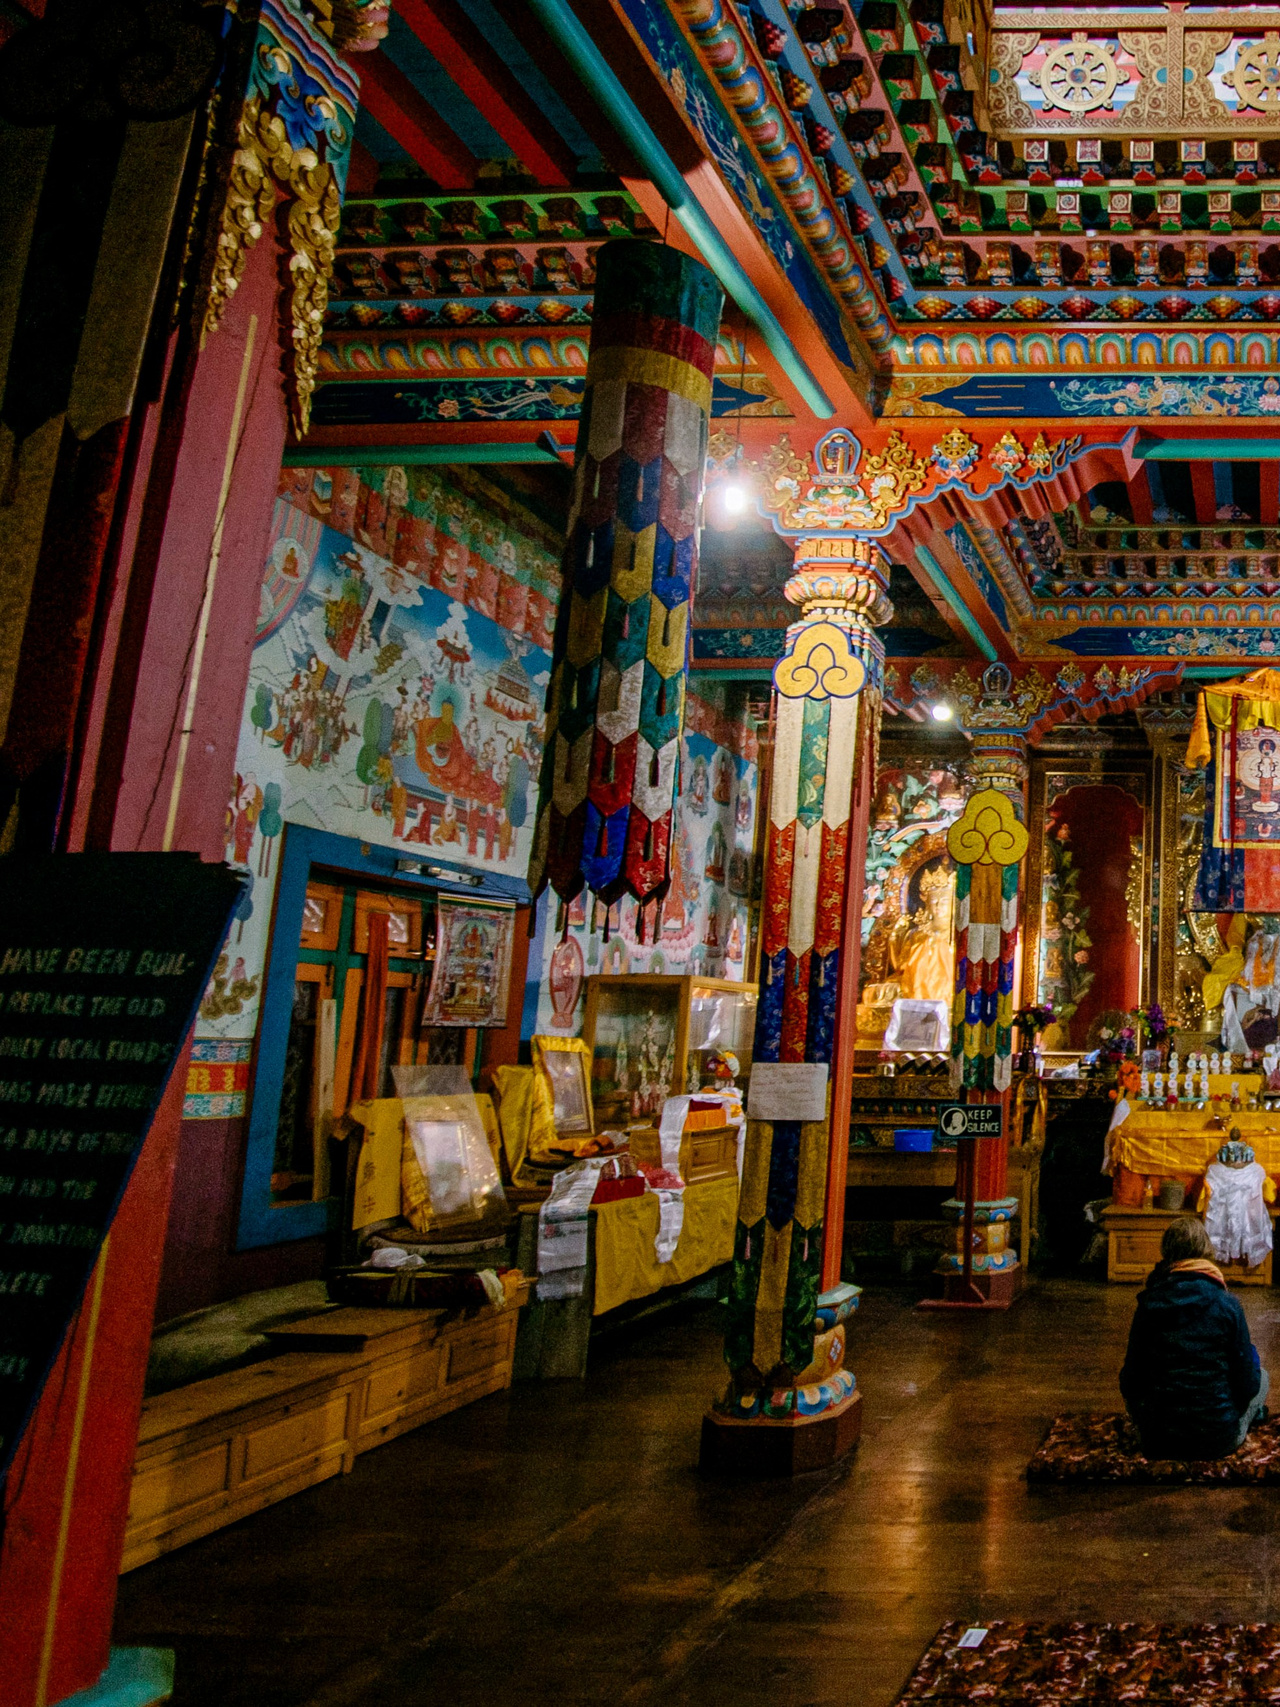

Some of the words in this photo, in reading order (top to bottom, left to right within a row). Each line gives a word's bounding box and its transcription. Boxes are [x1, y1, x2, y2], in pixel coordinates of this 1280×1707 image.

[0, 948, 61, 974] HAVE
[63, 947, 131, 974] BEEN
[7, 991, 85, 1017] REPLACE
[90, 996, 126, 1017] THE
[127, 997, 166, 1017] OLD
[48, 1038, 101, 1060] LOCAL
[106, 1040, 174, 1063] FUNDS
[967, 1109, 993, 1120] KEEP
[967, 1122, 999, 1133] SILENCE
[21, 1129, 74, 1155] DAYS
[77, 1132, 102, 1152] OF
[17, 1178, 57, 1198] AND
[62, 1179, 98, 1200] THE
